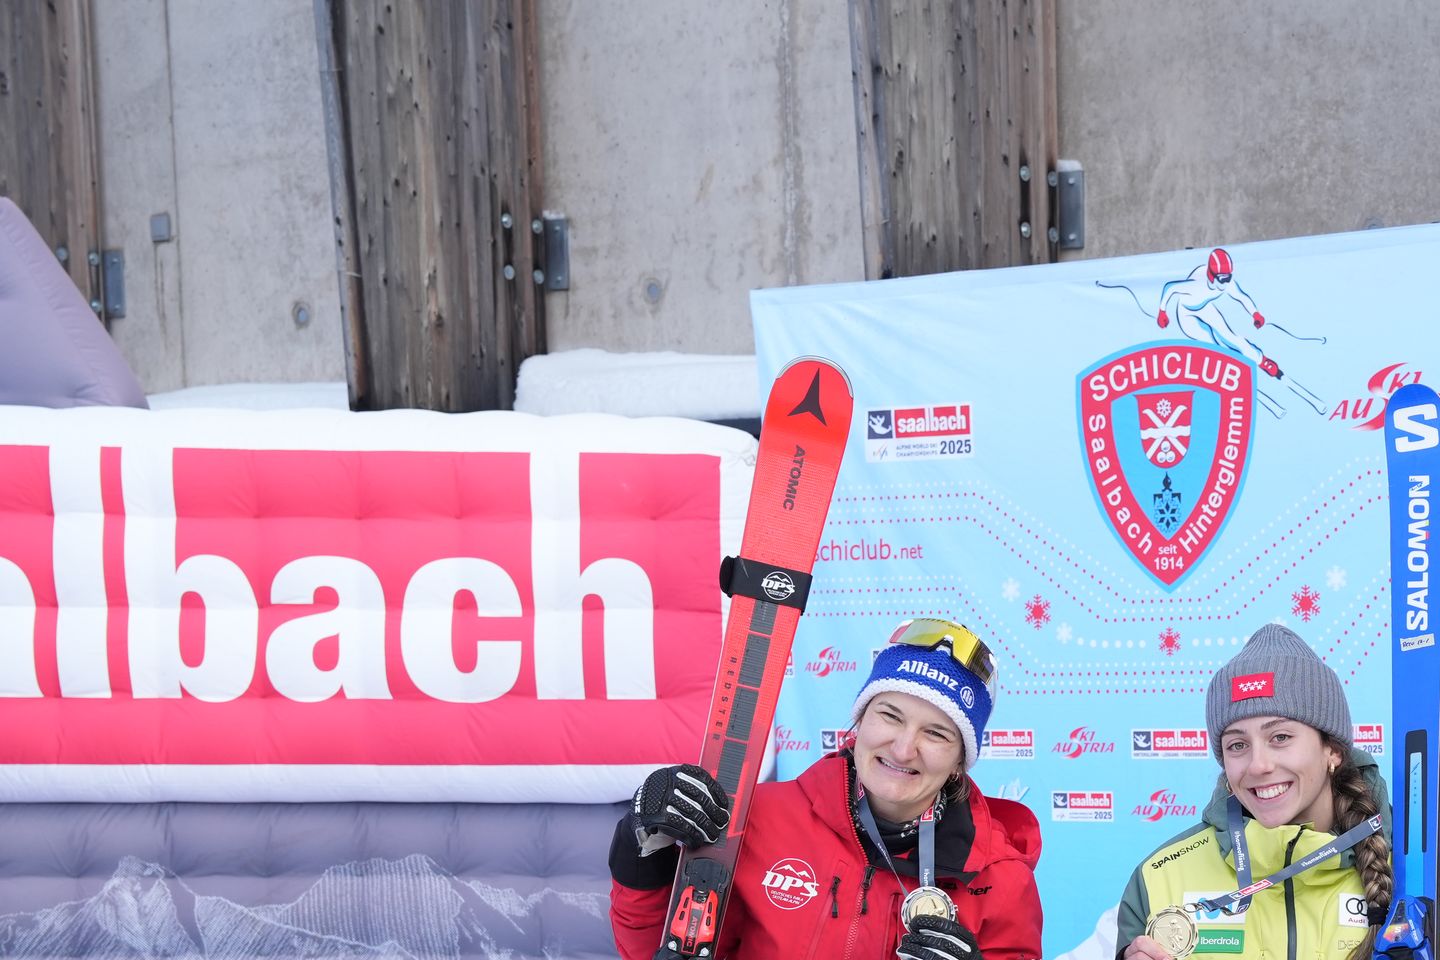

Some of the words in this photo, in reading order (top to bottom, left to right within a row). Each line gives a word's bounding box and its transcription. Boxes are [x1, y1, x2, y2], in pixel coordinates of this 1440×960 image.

[1089, 351, 1243, 402] SCHICLUB
[897, 406, 967, 434] saalbach
[940, 439, 972, 455] 2025
[782, 444, 806, 511] ATOMIC
[1178, 396, 1245, 554] Hinterglemm
[1088, 413, 1154, 556] Saalbach
[1158, 545, 1178, 555] seit
[1406, 475, 1431, 632] SALOMON
[1154, 556, 1185, 571] 1914
[761, 576, 797, 596] DPS
[897, 660, 960, 691] Allianz
[993, 732, 1031, 746] saalbach
[1155, 731, 1205, 748] saalbach
[1015, 748, 1033, 757] 2025
[1052, 741, 1116, 758] AUSTRIA
[1362, 744, 1383, 754] 2025
[1071, 792, 1110, 807] saalbach
[1094, 811, 1113, 820] 2025
[1131, 803, 1197, 821] AUSTRIA
[1151, 836, 1210, 870] SPAINSNOW
[761, 869, 820, 898] DPS
[968, 884, 993, 897] ner
[686, 915, 698, 948] ATOMIC
